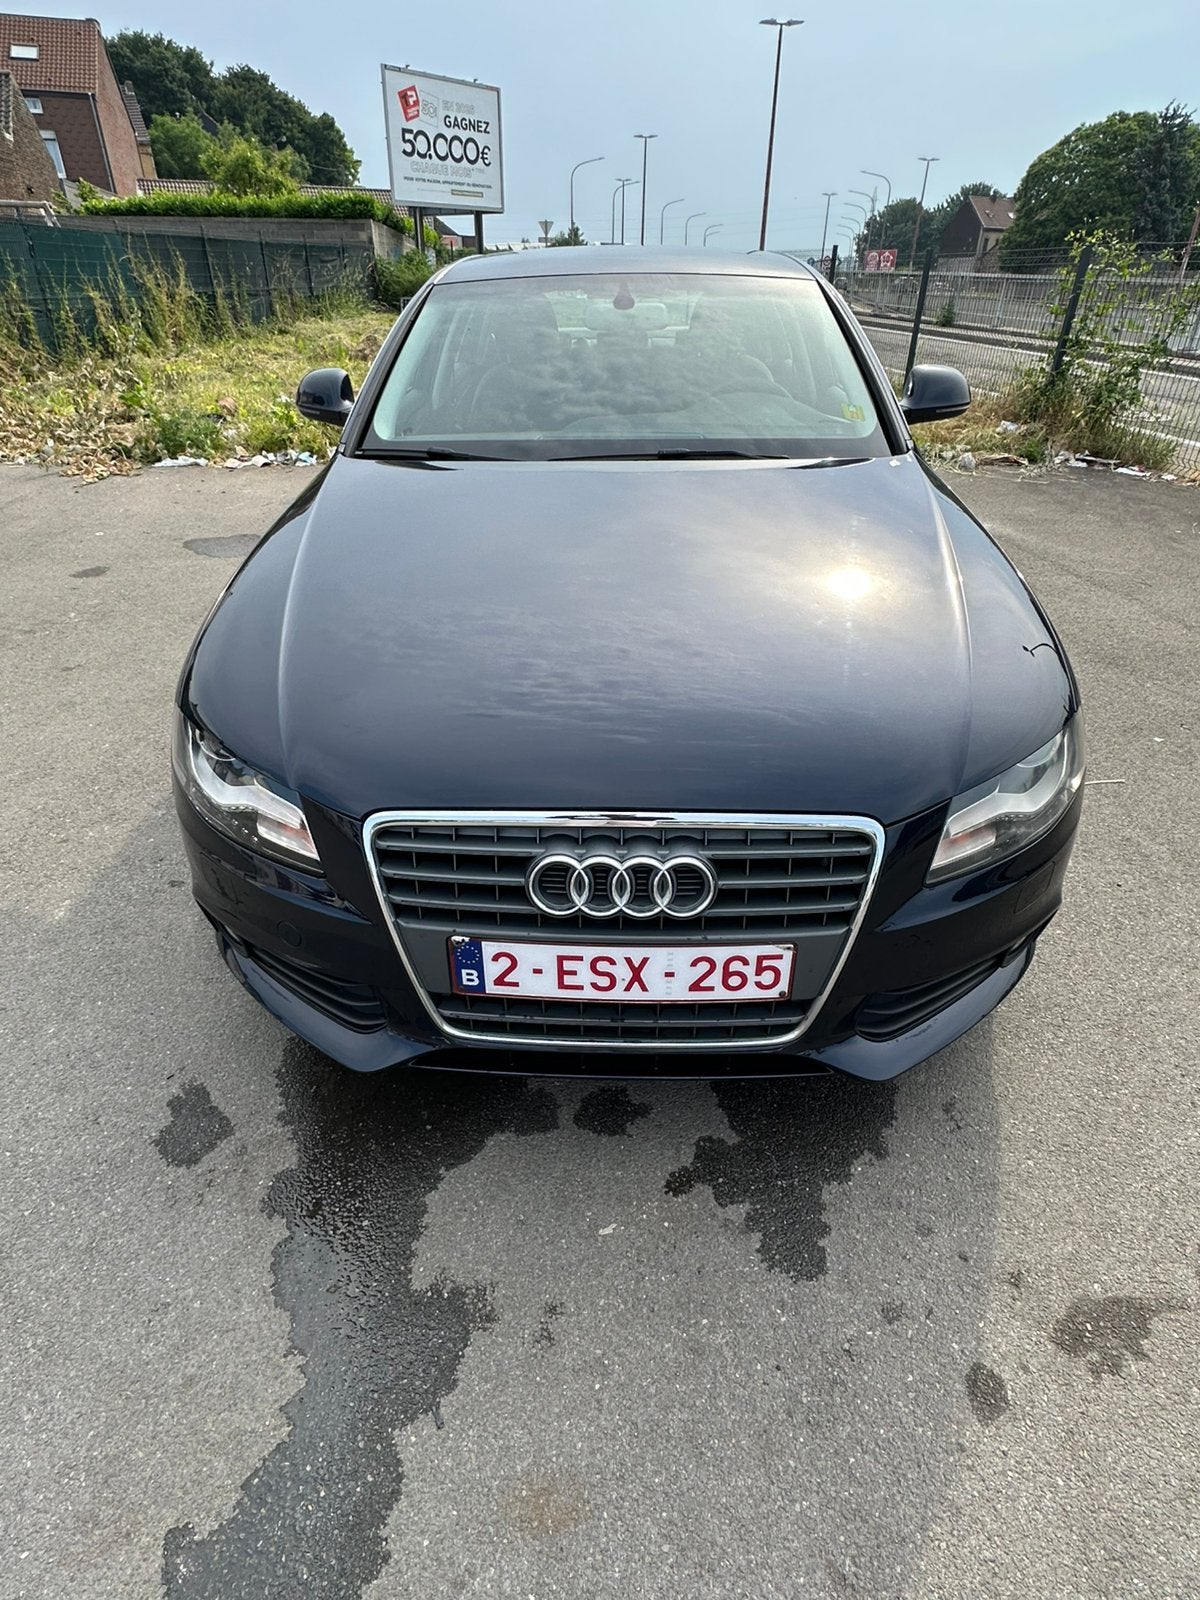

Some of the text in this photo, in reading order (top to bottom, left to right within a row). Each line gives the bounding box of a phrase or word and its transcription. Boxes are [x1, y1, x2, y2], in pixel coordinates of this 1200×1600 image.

[443, 114, 490, 134] GAGNEZ
[401, 127, 491, 167] 50.000€
[410, 161, 449, 176] CHAQUE
[461, 969, 479, 986] B
